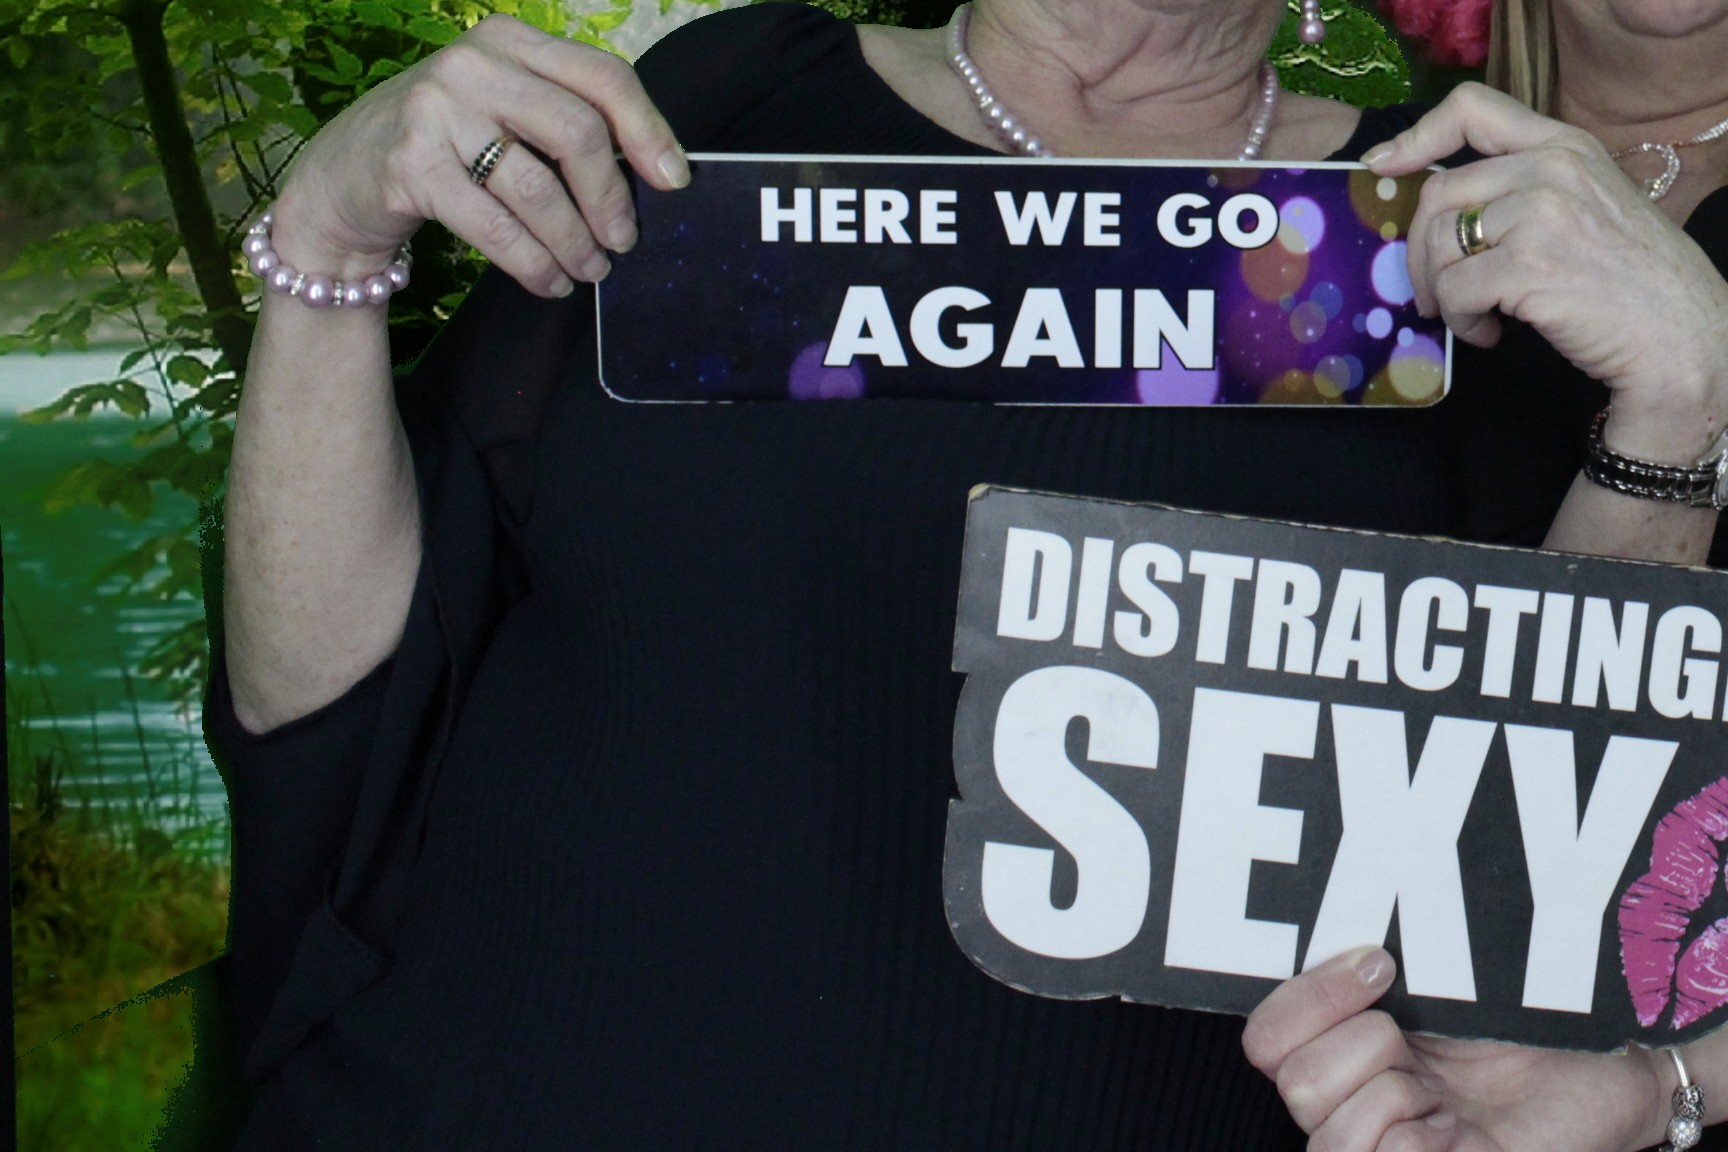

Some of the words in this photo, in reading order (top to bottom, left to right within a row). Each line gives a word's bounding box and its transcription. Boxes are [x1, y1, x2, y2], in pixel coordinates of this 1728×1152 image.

[760, 187, 958, 244] HERE
[994, 190, 1122, 247] WE
[1156, 192, 1280, 249] GO
[822, 285, 1216, 371] AGAIN
[981, 665, 1679, 1014] SEXY
